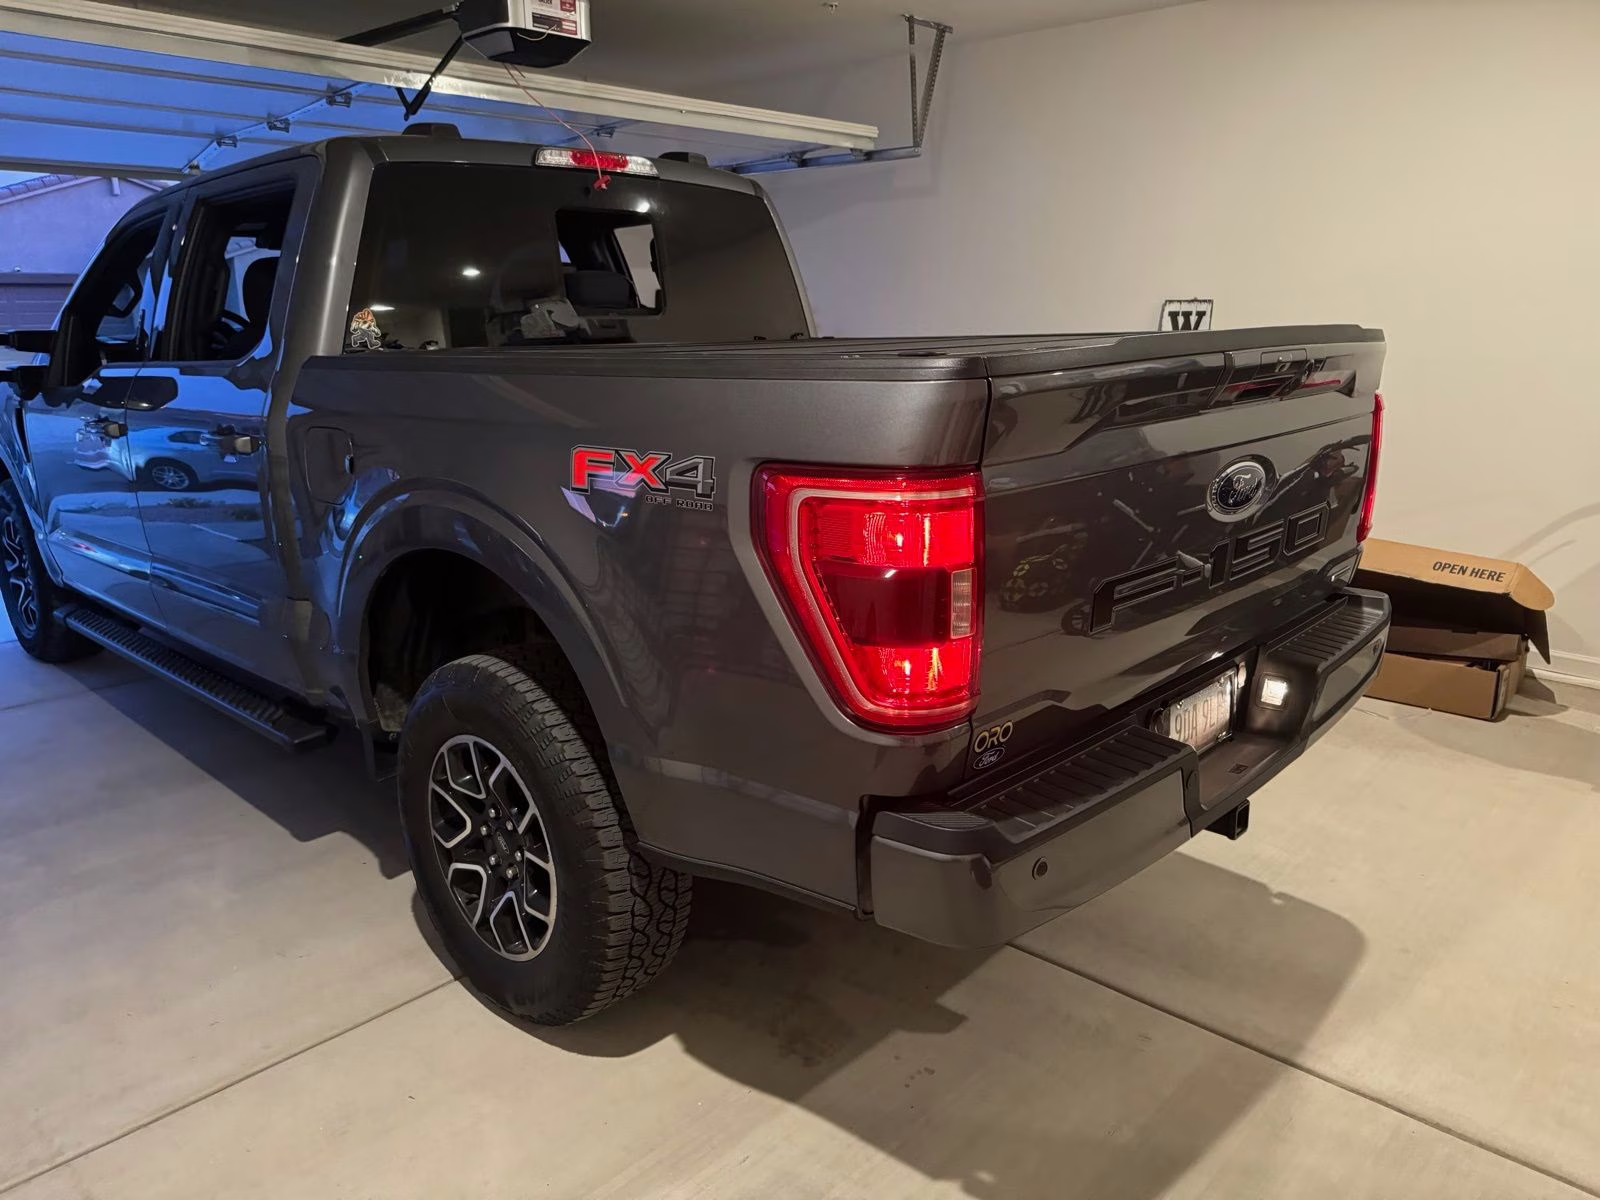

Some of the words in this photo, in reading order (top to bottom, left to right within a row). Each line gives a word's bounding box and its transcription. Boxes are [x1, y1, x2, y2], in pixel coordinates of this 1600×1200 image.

[1168, 311, 1206, 331] W
[570, 444, 716, 500] FX4
[645, 494, 671, 505] OFF
[676, 498, 714, 511] ROAD
[1089, 500, 1331, 634] F-150
[1432, 561, 1468, 576] OPEN
[1469, 567, 1506, 583] HERE
[974, 721, 1013, 753] ORO
[978, 750, 999, 767] Ford
